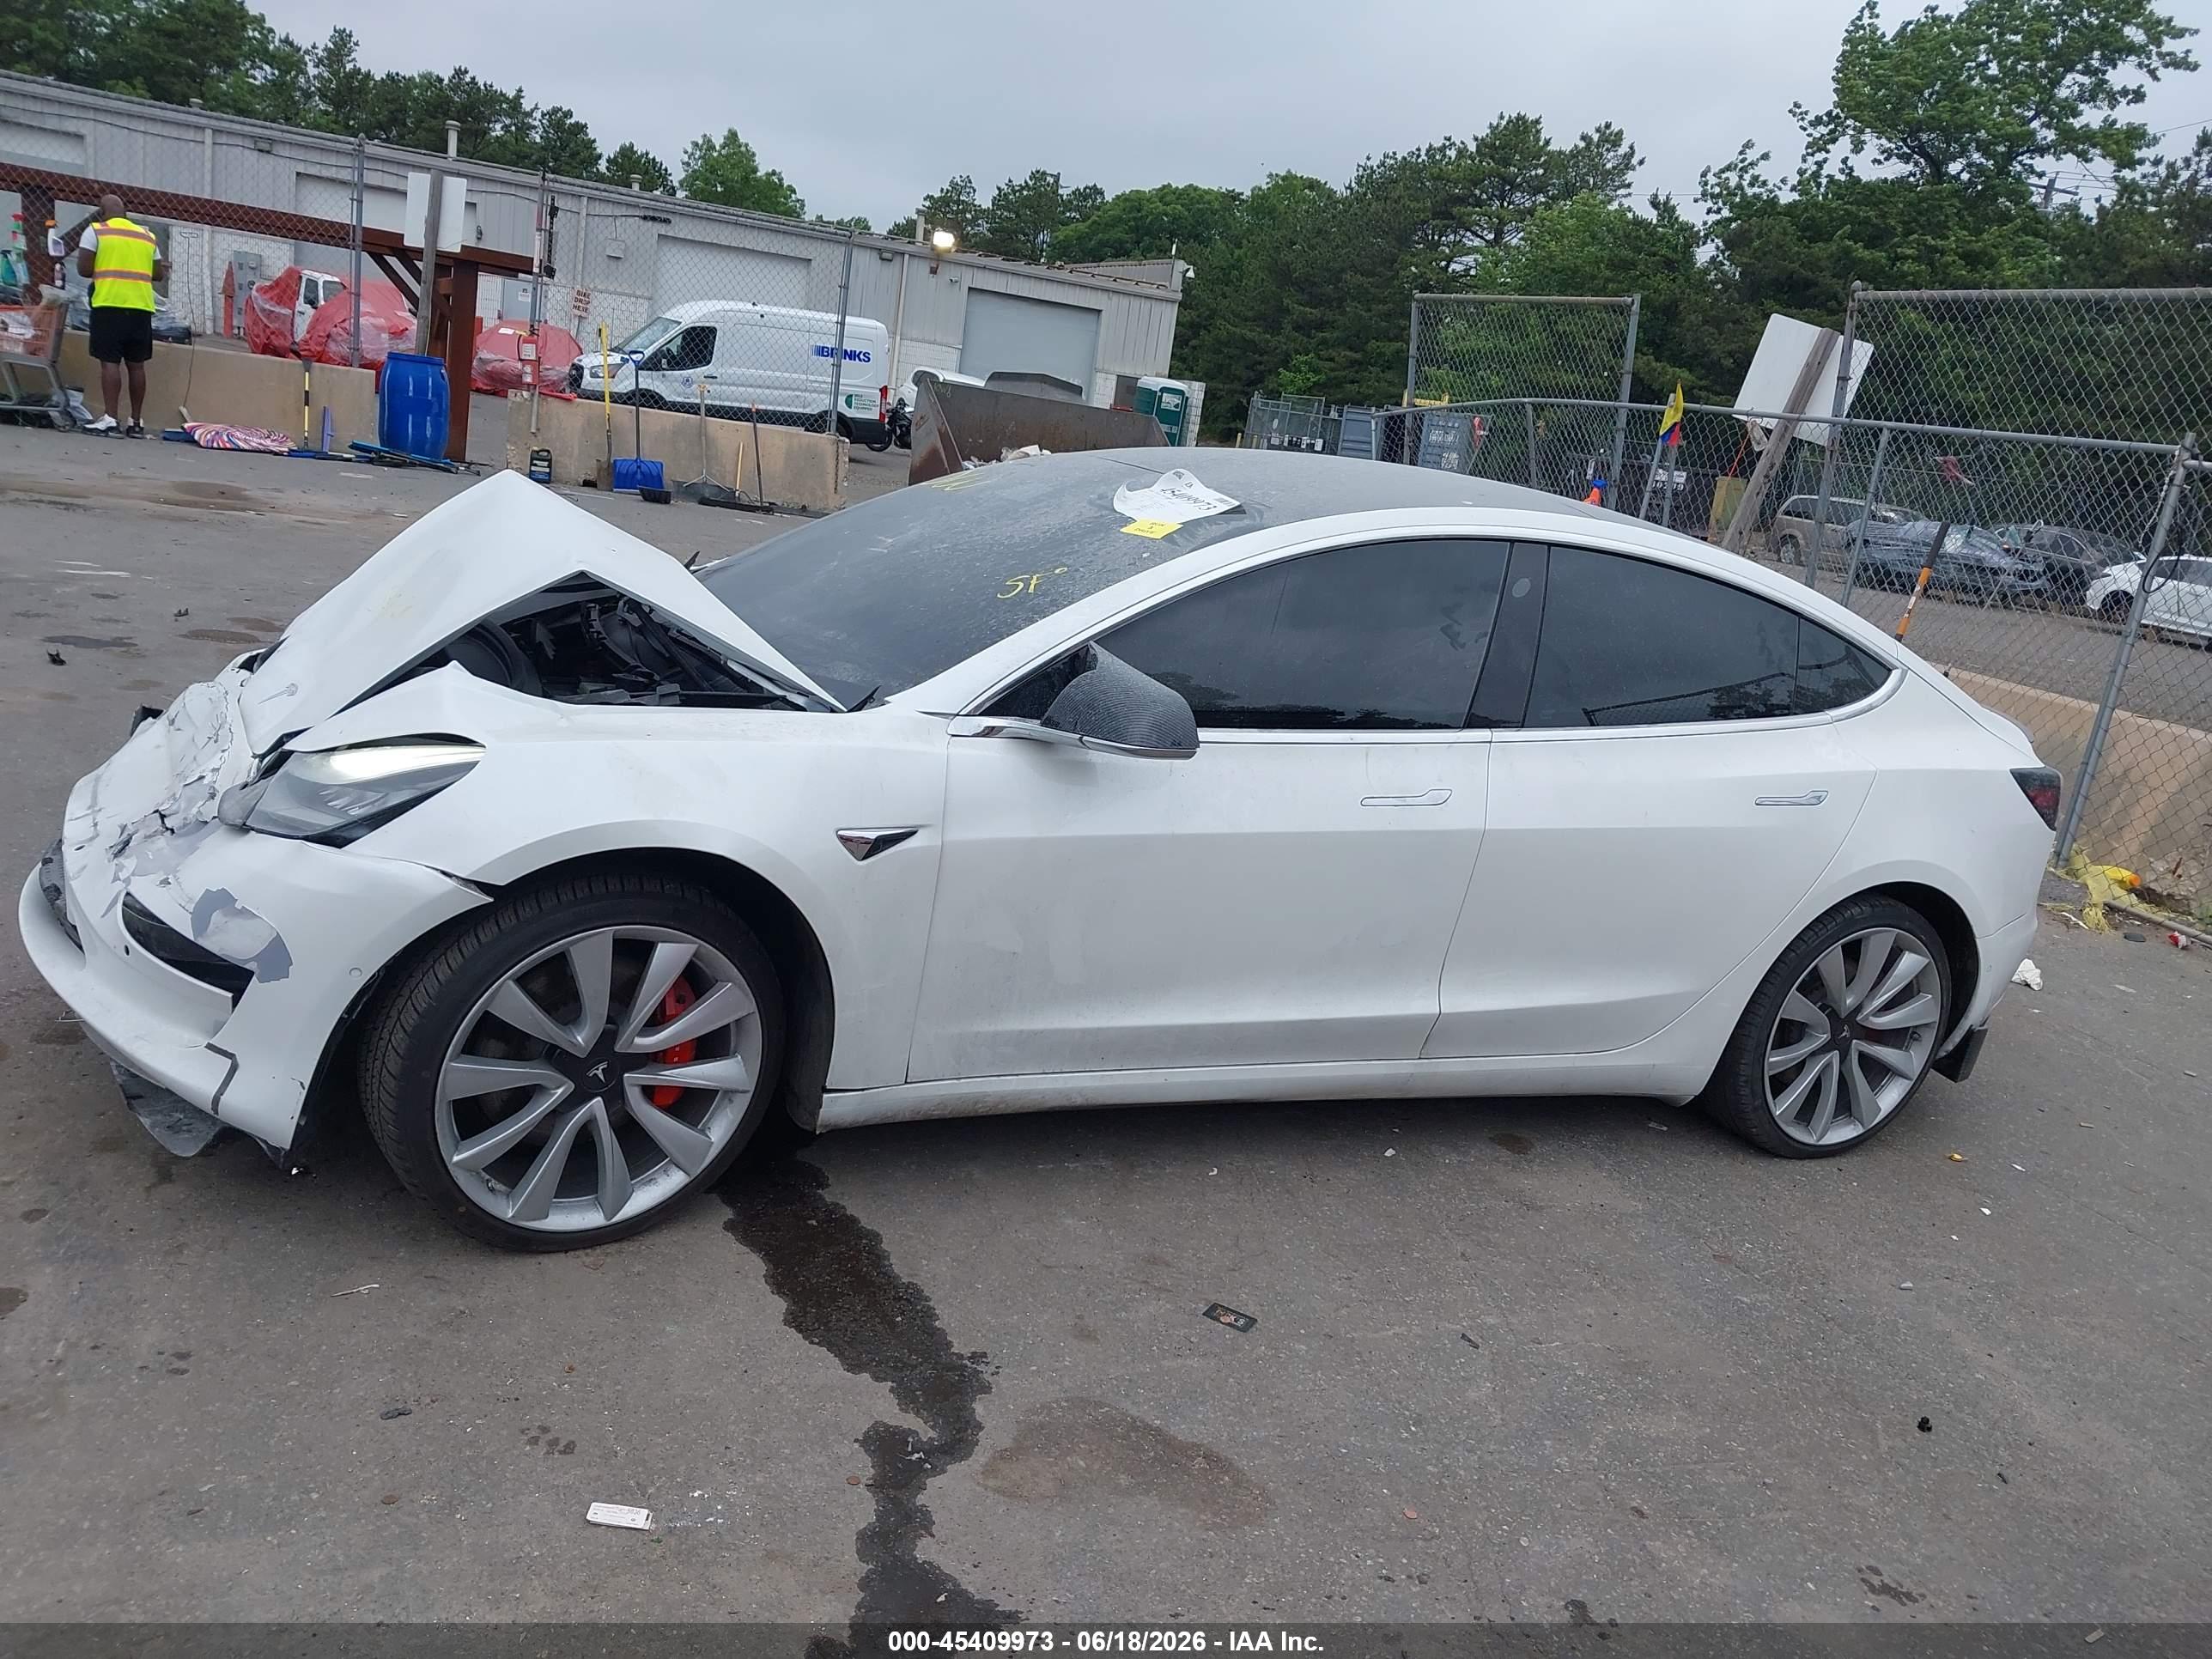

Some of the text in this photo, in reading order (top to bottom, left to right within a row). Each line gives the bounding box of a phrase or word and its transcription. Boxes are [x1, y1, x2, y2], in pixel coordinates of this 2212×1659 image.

[576, 289, 592, 300] BIKE
[574, 296, 591, 306] DROP
[821, 345, 871, 363] BRNKS
